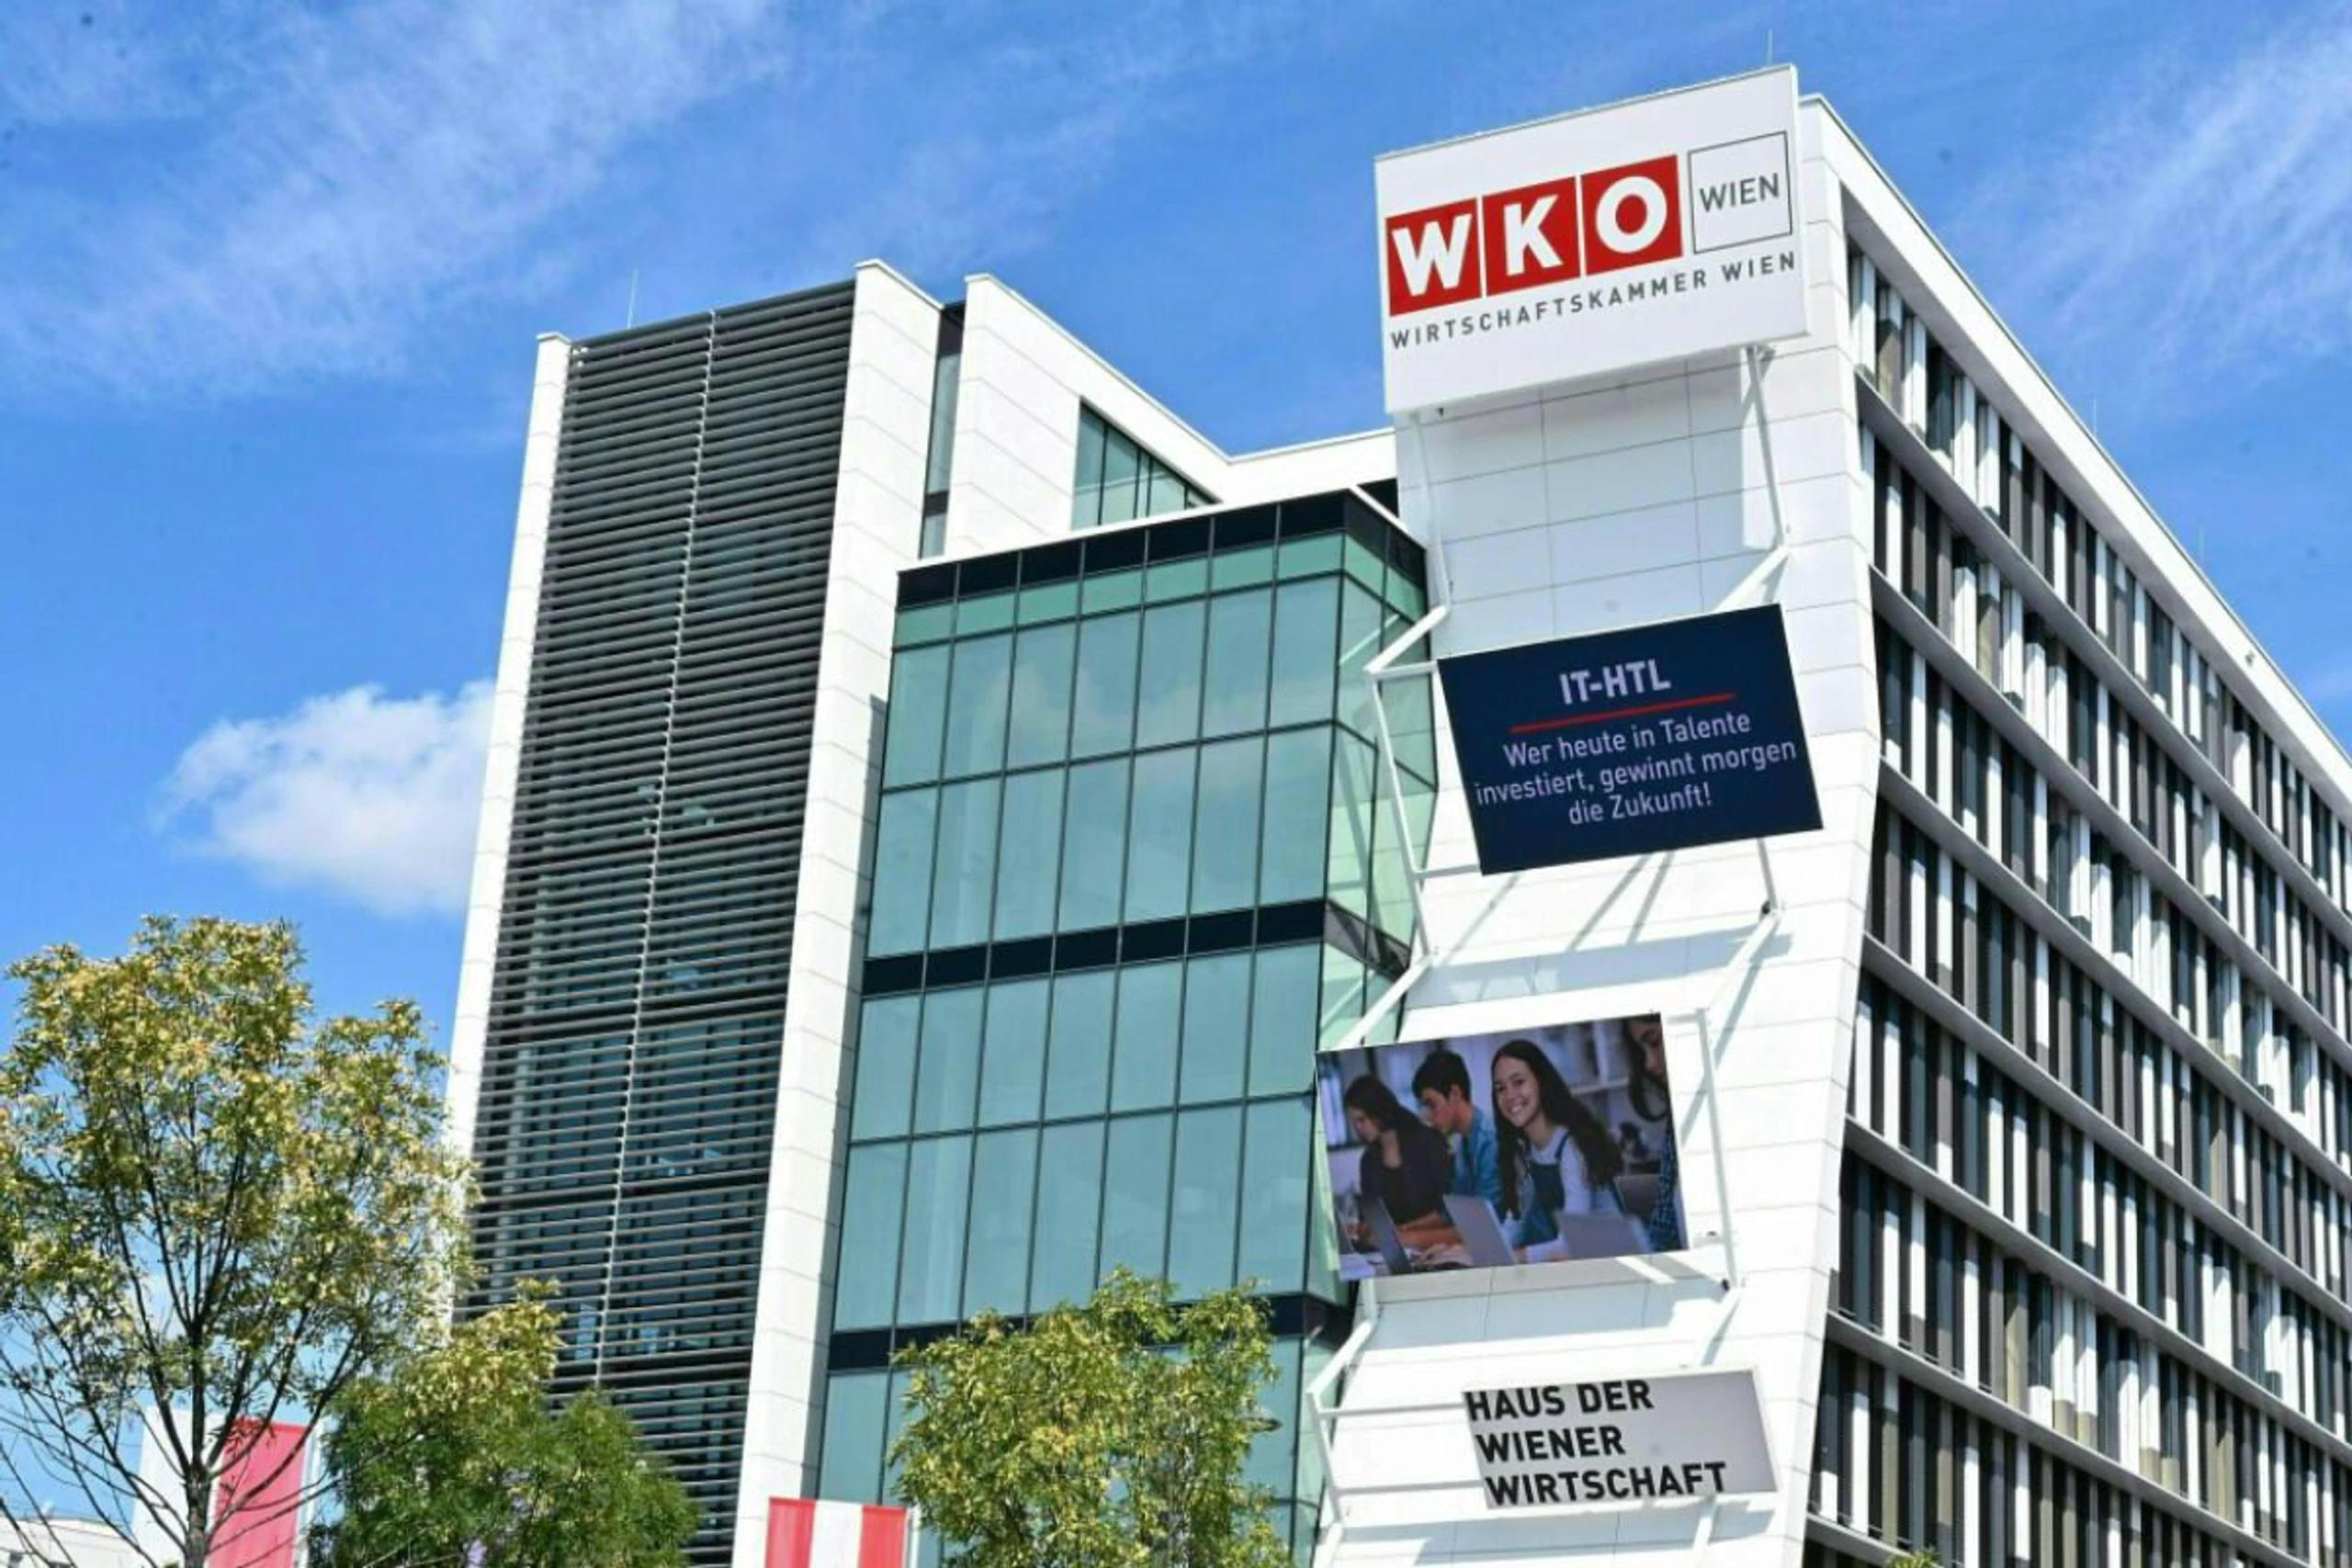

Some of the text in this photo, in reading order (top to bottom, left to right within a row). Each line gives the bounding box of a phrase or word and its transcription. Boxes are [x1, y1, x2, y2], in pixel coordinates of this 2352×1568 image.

[1699, 173, 1781, 212] WIEN
[1391, 175, 1668, 298] WKO
[1390, 251, 1797, 349] WIRTSCHAFTSKAMMER WIEN
[1560, 659, 1671, 705] IT-HTL
[1503, 710, 1751, 768] Wer heute in Talente
[1476, 740, 1797, 806] investiert, gewinnt morgen
[1567, 781, 1713, 825] die Zukunft!
[1464, 1379, 1655, 1423] HAUS DER
[1475, 1425, 1626, 1464] WIENER
[1484, 1461, 1727, 1506] WIRTSCHAFT
